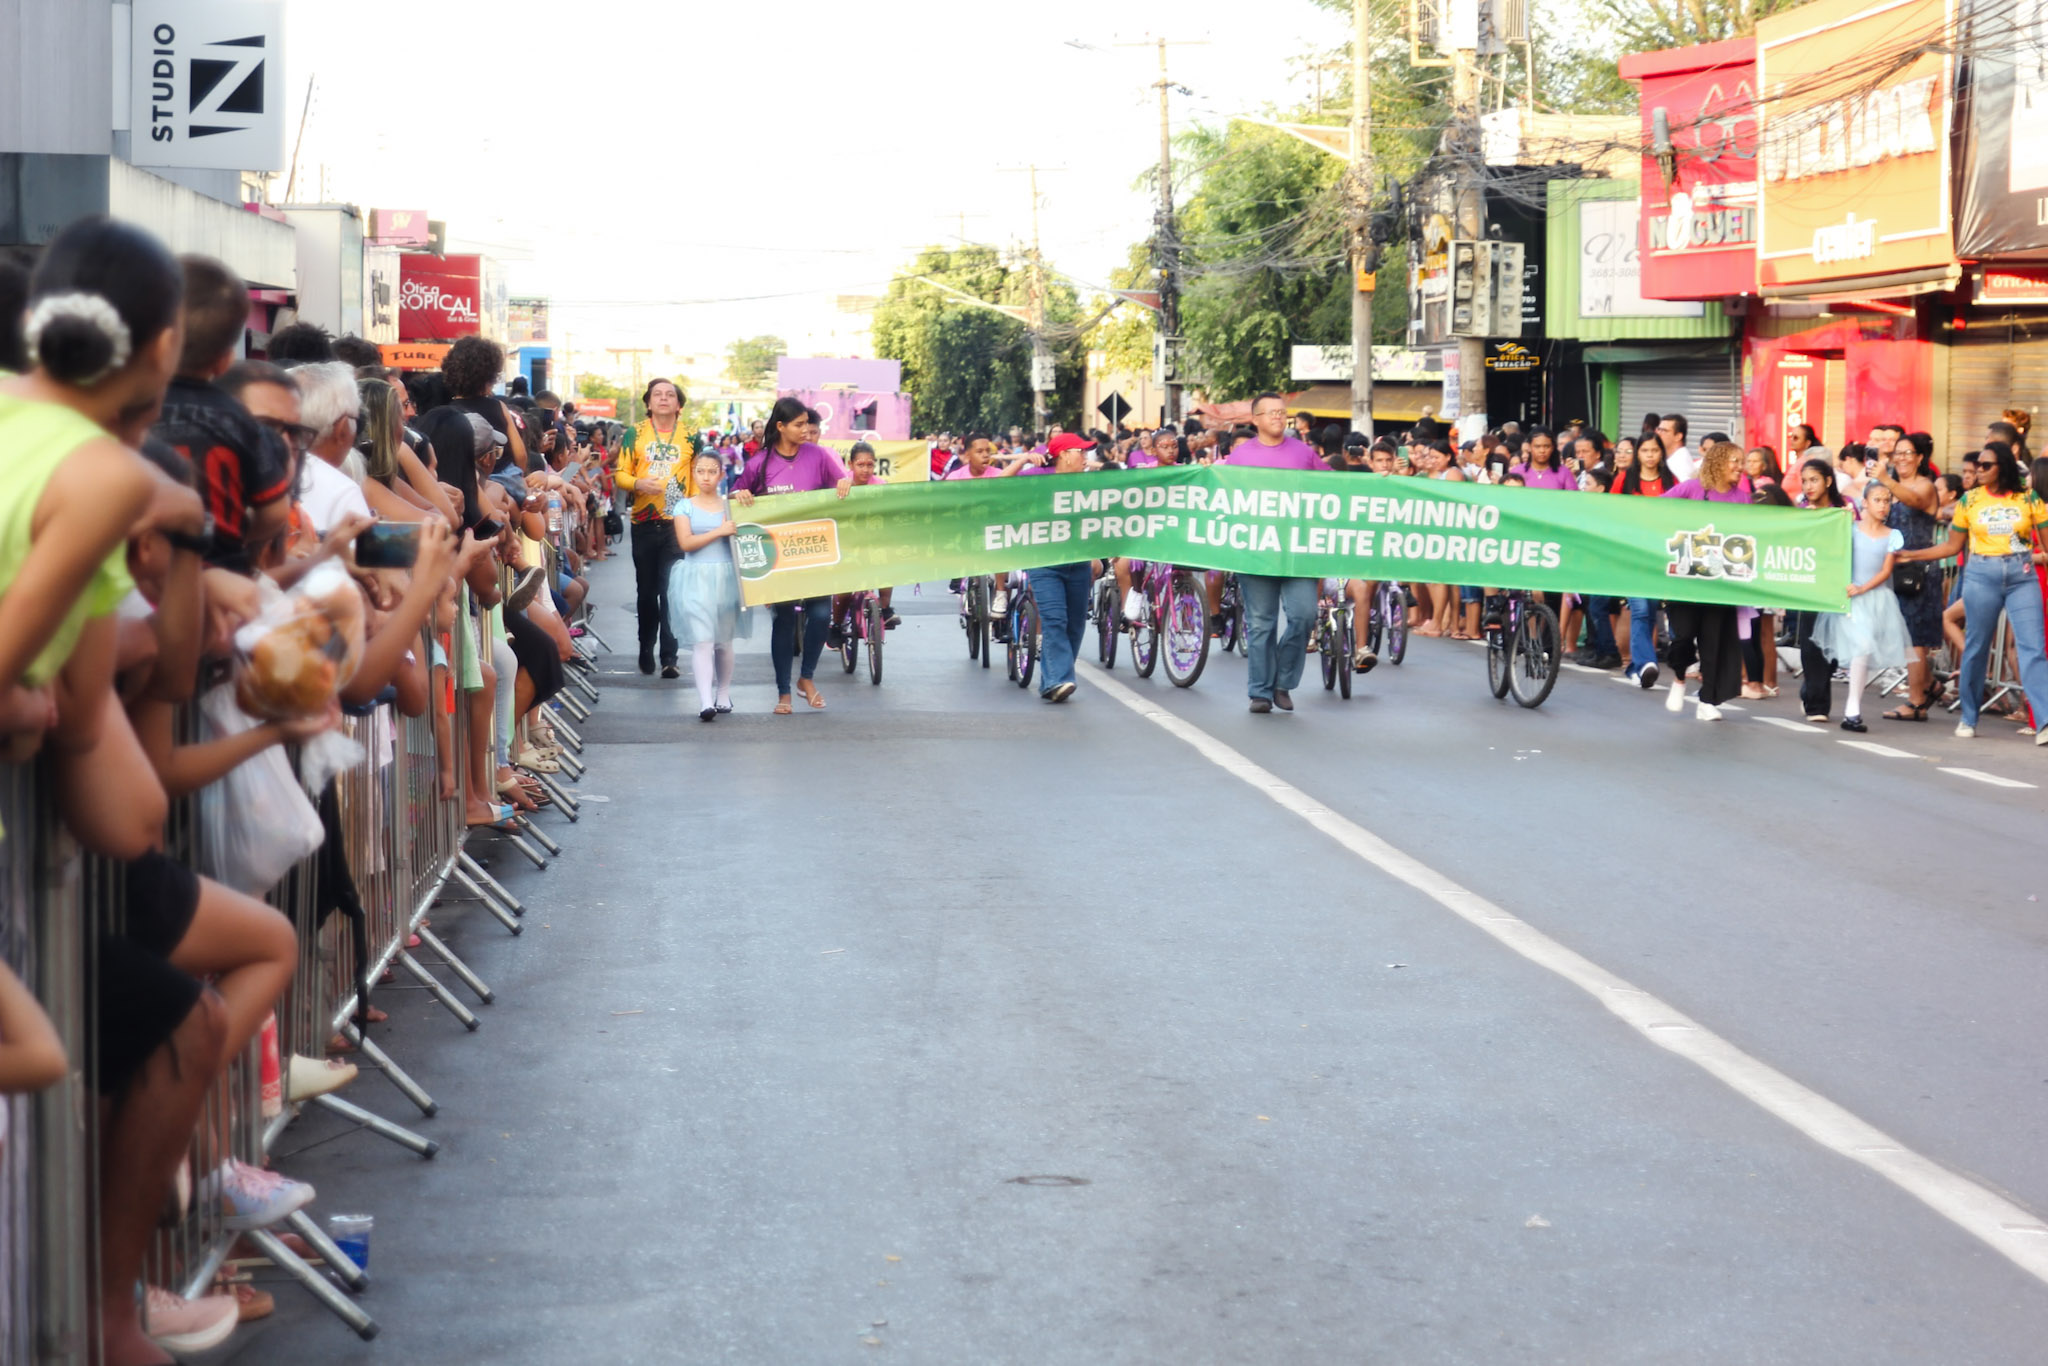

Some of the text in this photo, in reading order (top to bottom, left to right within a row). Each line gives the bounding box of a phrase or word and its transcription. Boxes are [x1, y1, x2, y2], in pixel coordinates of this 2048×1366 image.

[151, 23, 175, 142] STUDIO
[402, 278, 440, 298] Ótica
[399, 293, 477, 317] ROPICAL
[1493, 360, 1532, 369] ESTAÇÃO
[1499, 352, 1525, 361] ÓTICA
[1053, 485, 1500, 531] EMPODERAMENTO FEMININO
[780, 535, 828, 548] VÁRZEA
[782, 543, 830, 557] GRANDE
[984, 520, 1071, 551] EMEB
[1187, 513, 1282, 552] LÚCIA
[1289, 526, 1375, 556] LEITE
[1381, 531, 1562, 569] RODRIGUES
[1666, 528, 1758, 582] 159
[1763, 545, 1817, 572] ANOS
